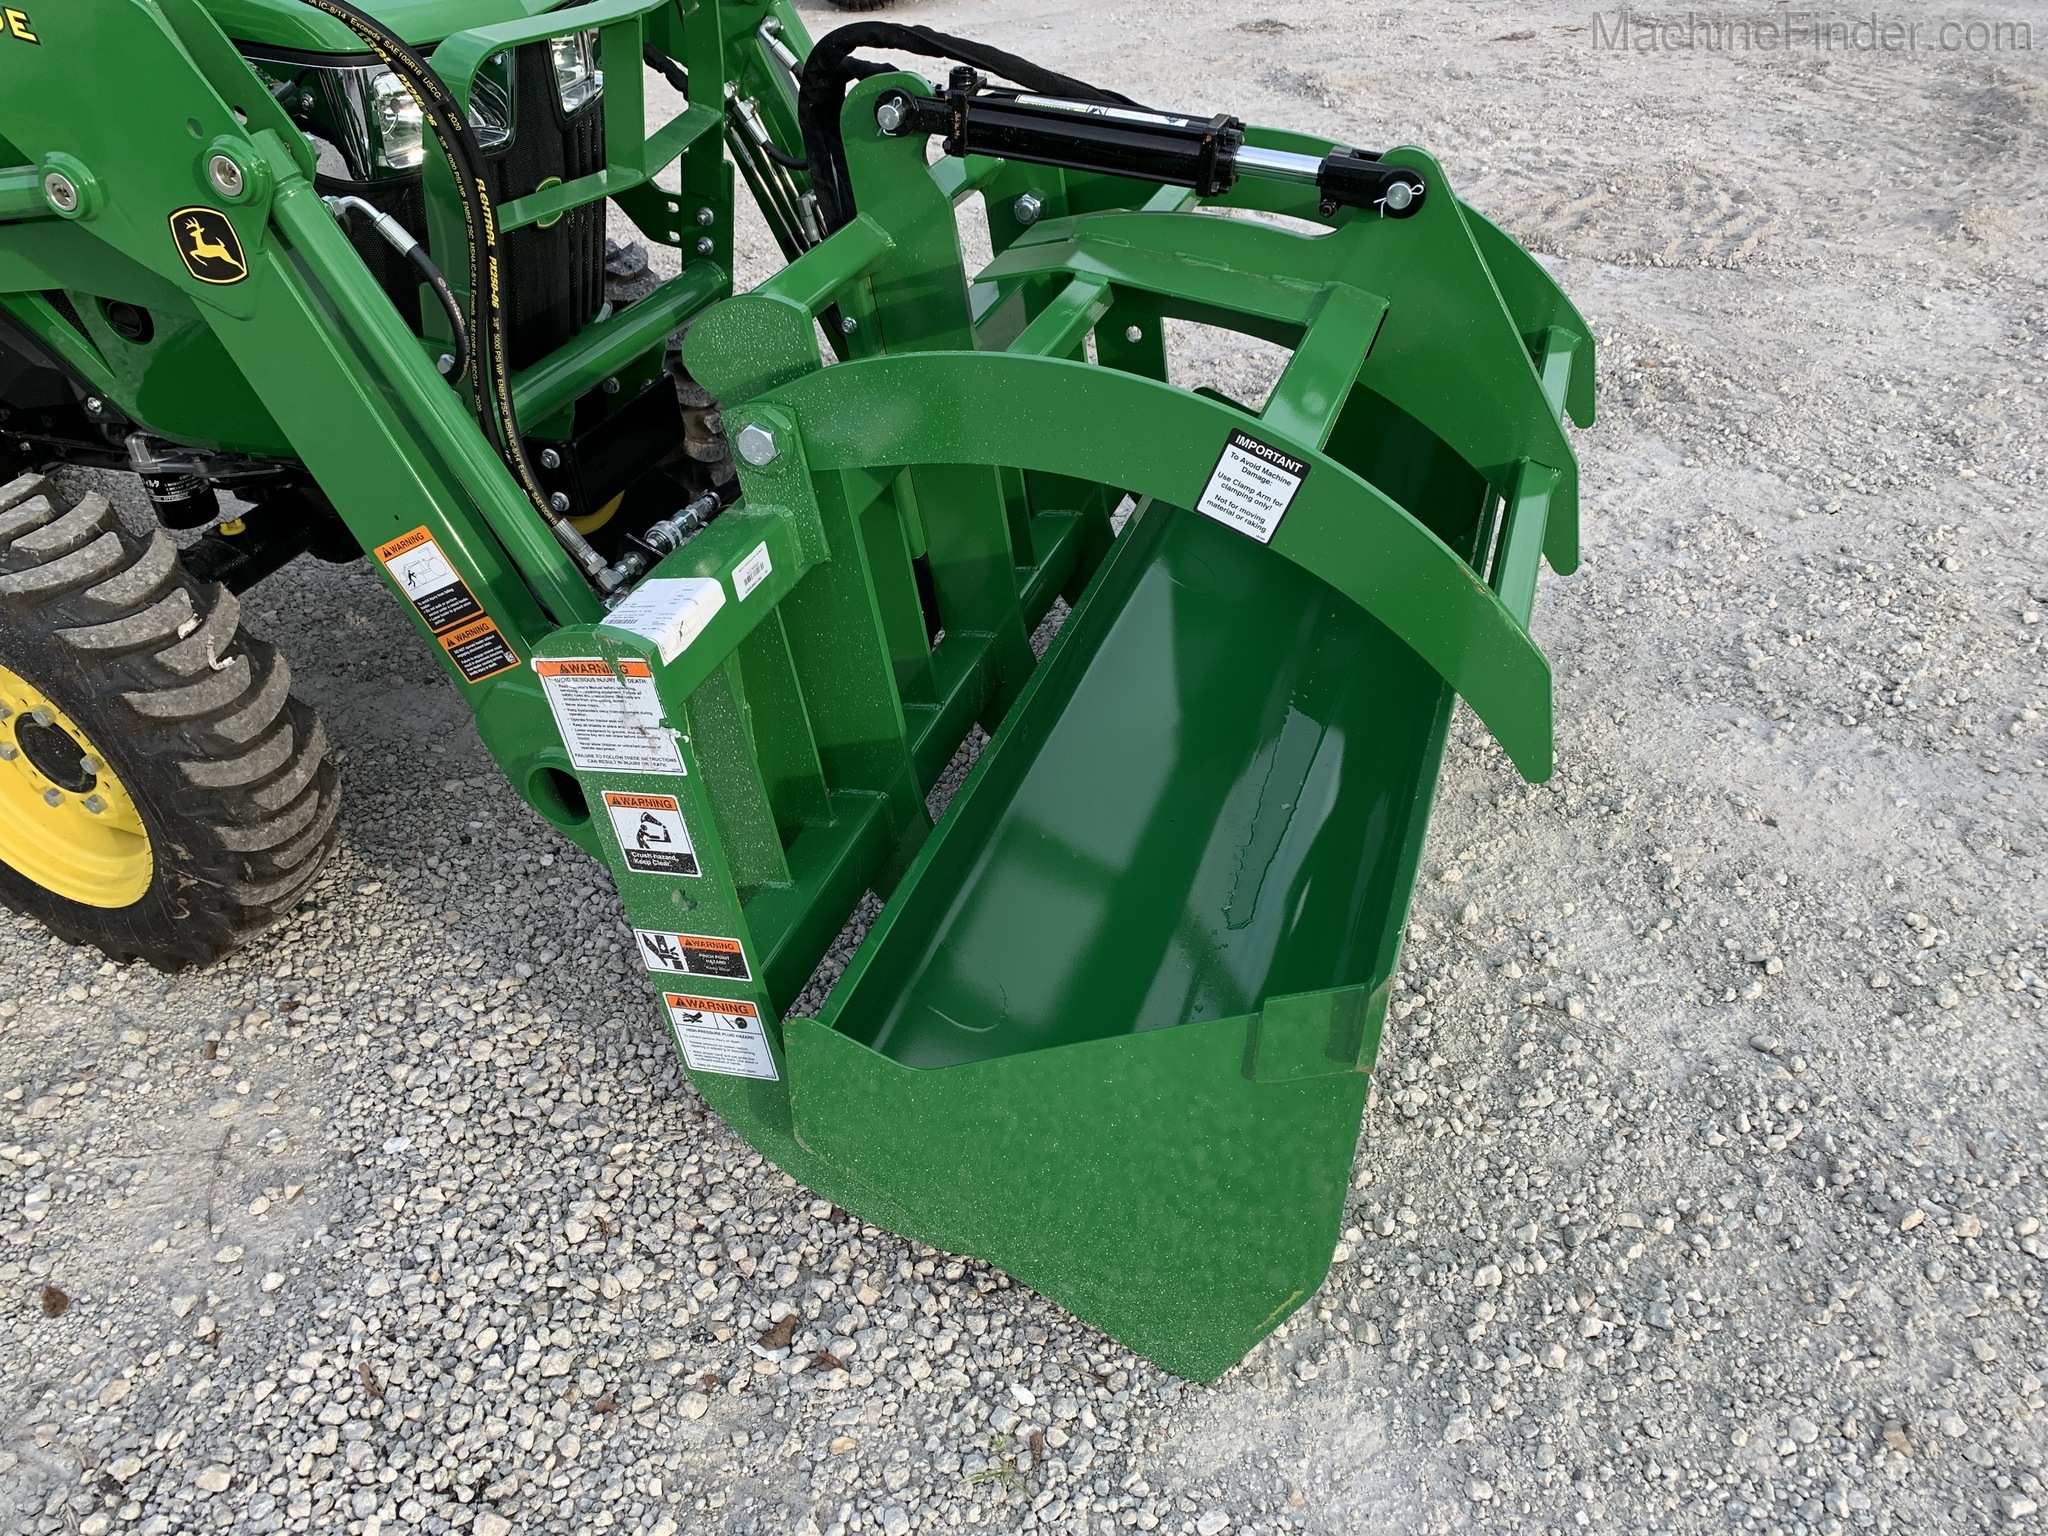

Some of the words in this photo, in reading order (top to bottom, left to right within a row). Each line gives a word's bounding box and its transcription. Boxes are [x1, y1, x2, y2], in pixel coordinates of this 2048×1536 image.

[0, 6, 41, 46] E
[350, 17, 381, 41] Exceeds
[447, 112, 462, 131] 2Q20
[488, 255, 500, 309] PX250-06
[497, 378, 506, 400] EN857
[500, 400, 509, 416] 2SC
[504, 418, 514, 439] MSHA
[1235, 434, 1303, 473] IMPORTANT
[517, 464, 533, 491] Exceeds
[1229, 452, 1240, 460] To
[1239, 456, 1261, 471] Avoid
[1261, 467, 1292, 486] Machine
[1240, 466, 1273, 487] Damage:
[1217, 471, 1232, 482] Use
[1231, 478, 1256, 495] Clamp
[1256, 490, 1272, 502] Arm
[1272, 498, 1283, 508] for
[1220, 481, 1253, 503] clamping
[1253, 498, 1272, 512] only!
[1206, 498, 1235, 516] material
[1243, 517, 1267, 534] raking
[1214, 494, 1228, 505] Not
[1228, 501, 1239, 510] for
[1238, 506, 1266, 524] moving
[389, 532, 425, 554] WARNING
[453, 622, 490, 642] WARNING
[569, 664, 629, 674] WARNIG
[620, 797, 673, 809] WARNING
[633, 857, 651, 866] Keep
[692, 940, 735, 950] WARNING
[686, 999, 749, 1014] WARNING
